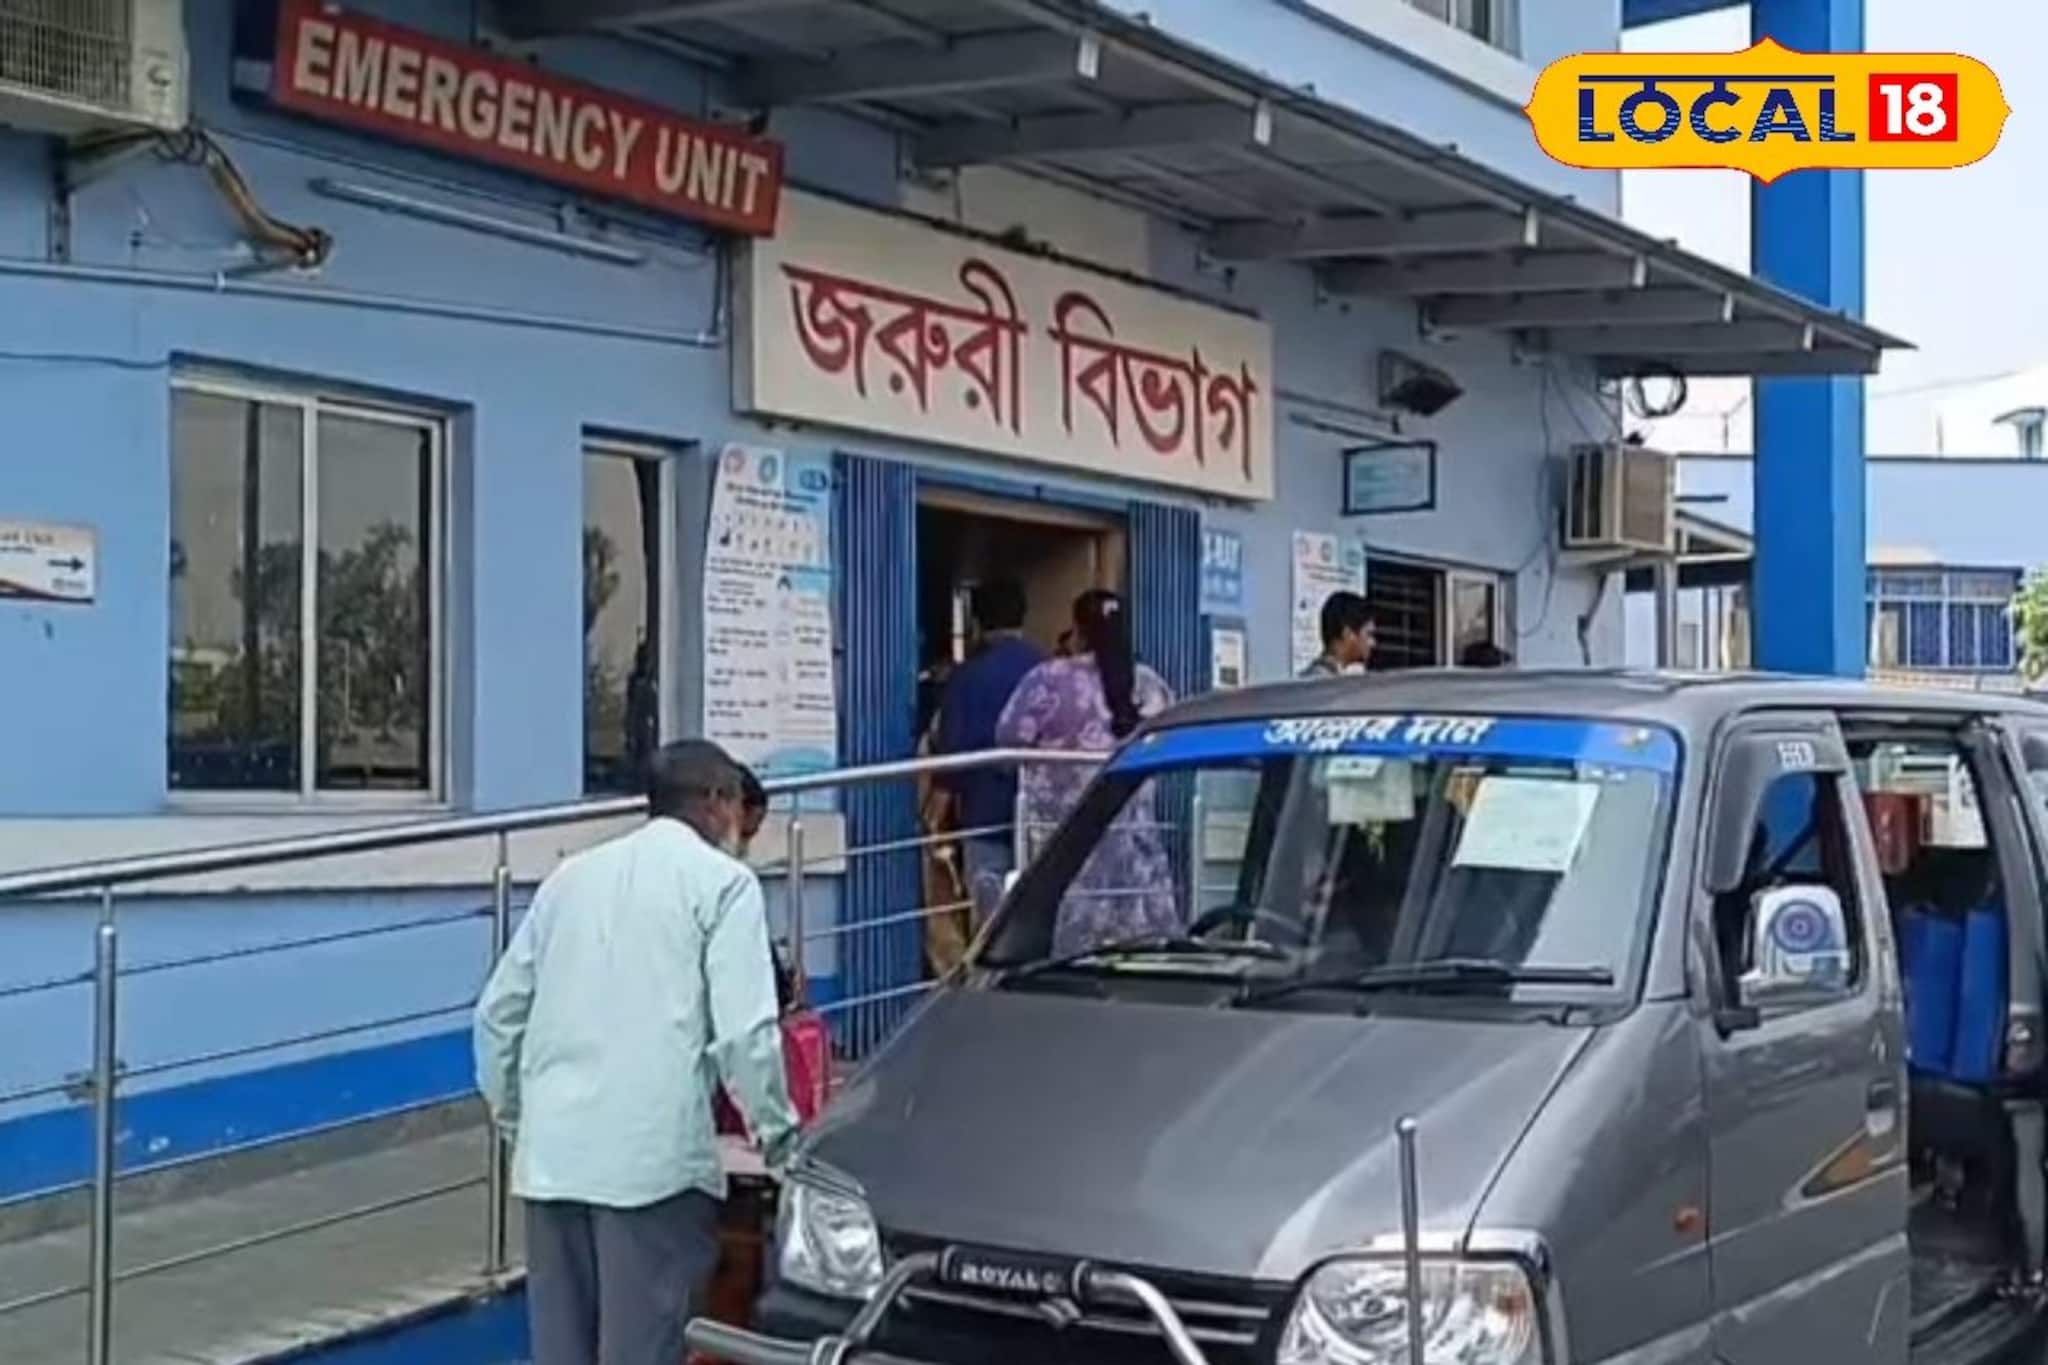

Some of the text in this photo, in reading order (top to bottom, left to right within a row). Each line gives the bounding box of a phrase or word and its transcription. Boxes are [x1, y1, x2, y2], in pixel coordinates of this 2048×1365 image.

[294, 20, 769, 215] EMERGENCY UNIT
[779, 258, 1257, 481] জরুরী বিভাগ
